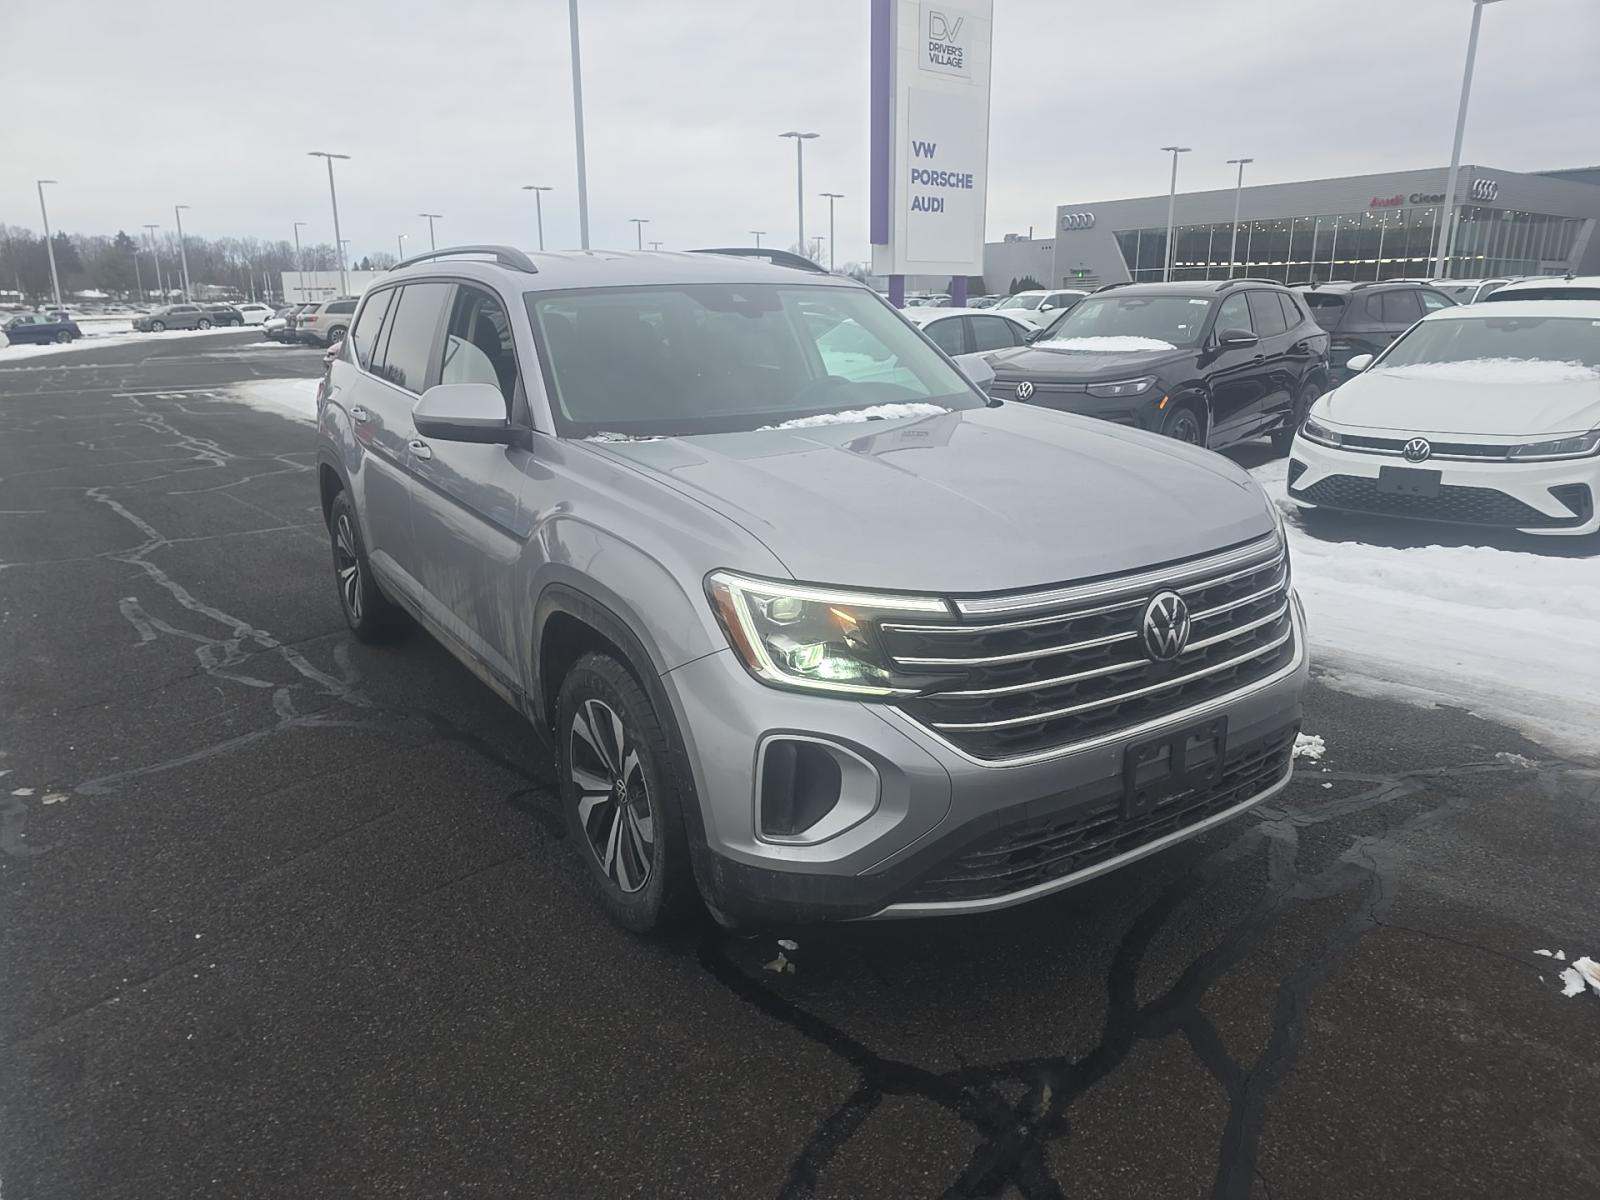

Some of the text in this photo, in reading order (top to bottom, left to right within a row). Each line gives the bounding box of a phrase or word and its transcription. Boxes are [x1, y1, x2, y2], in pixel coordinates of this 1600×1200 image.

[929, 10, 964, 43] DV
[928, 41, 963, 57] DRIVER'S
[928, 52, 963, 68] VILLAGE
[911, 140, 937, 159] VW
[911, 168, 973, 189] PORSCHE
[911, 195, 944, 213] AUDI
[1408, 192, 1455, 205] Cicer
